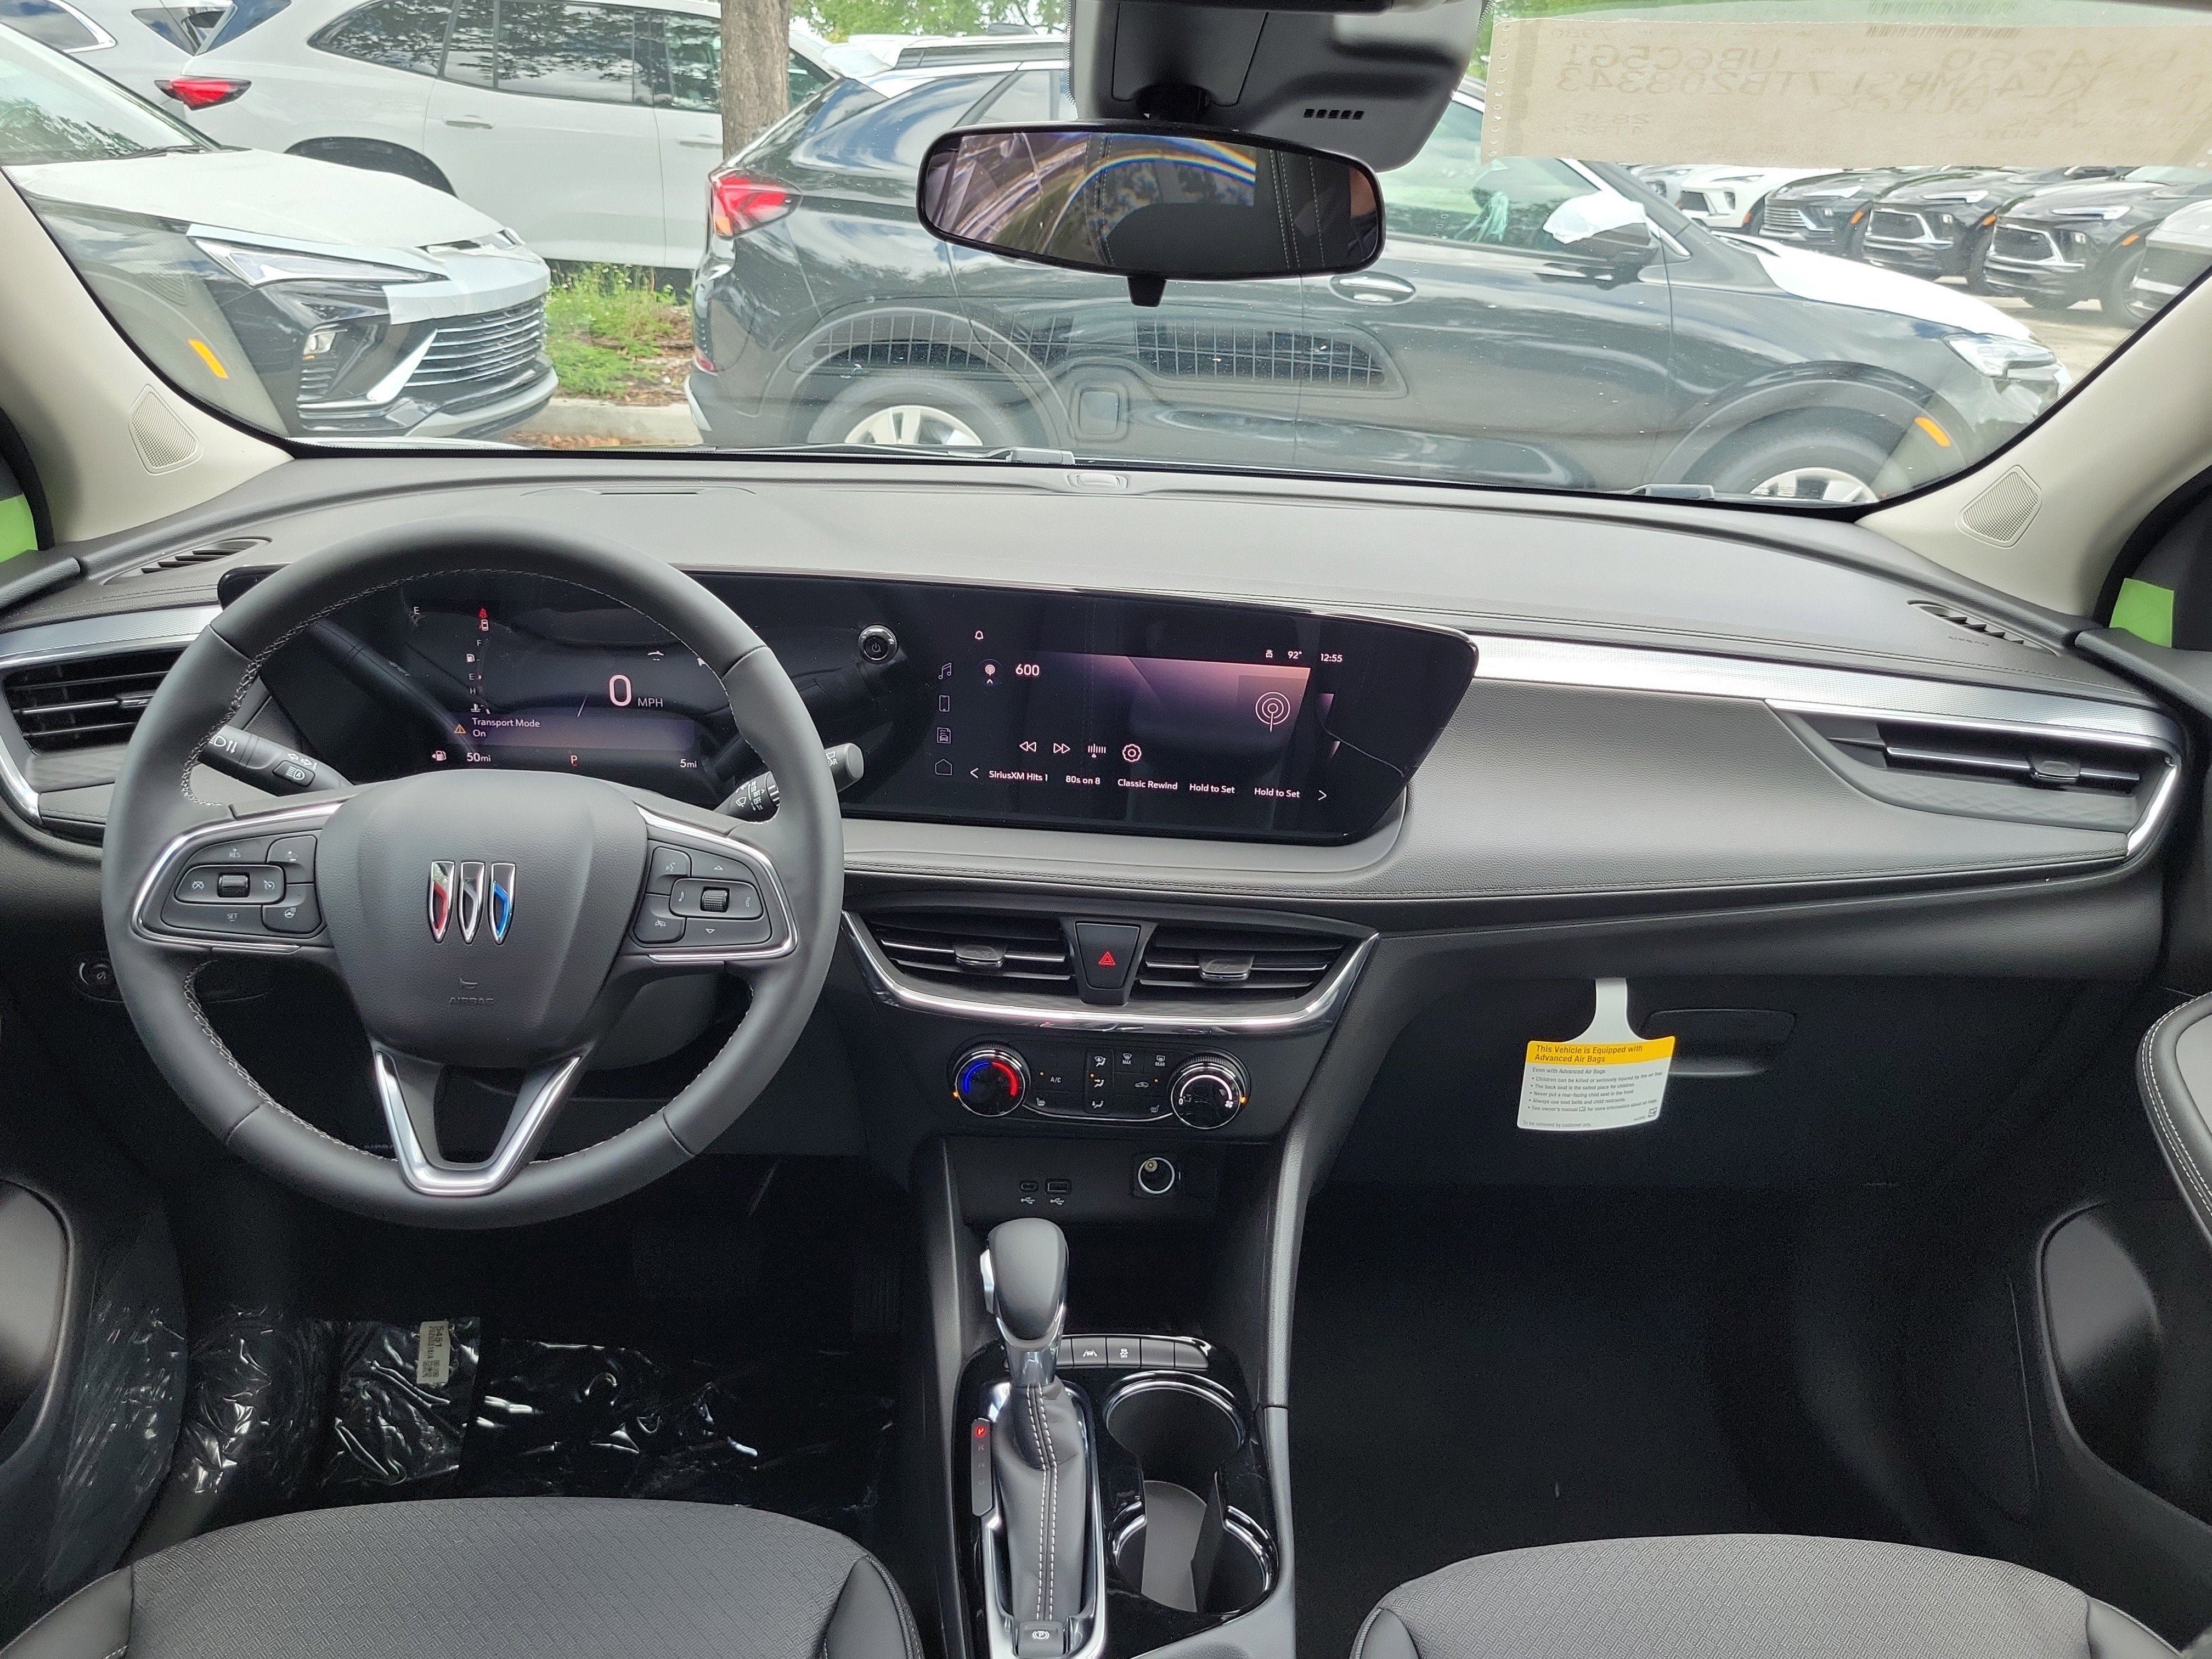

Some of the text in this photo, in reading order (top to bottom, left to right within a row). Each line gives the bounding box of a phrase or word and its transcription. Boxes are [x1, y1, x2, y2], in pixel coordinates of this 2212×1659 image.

[1321, 653, 1342, 662] 12:55
[1015, 663, 1040, 676] 600
[610, 675, 631, 706] 0
[637, 697, 663, 707] MPH
[472, 718, 540, 727] Transport Mode
[571, 755, 578, 764] P
[989, 770, 1024, 780] SiriusXM
[1026, 773, 1043, 781] Hits
[1066, 775, 1081, 783] 80s
[1118, 778, 1178, 790] Classic Rewind
[1189, 783, 1209, 792] Hold
[1254, 787, 1273, 796] Hold
[1285, 789, 1300, 798] Set
[753, 796, 761, 805] OFF
[1593, 1046, 1626, 1054] Equipped
[1534, 1053, 1572, 1062] Advanced
